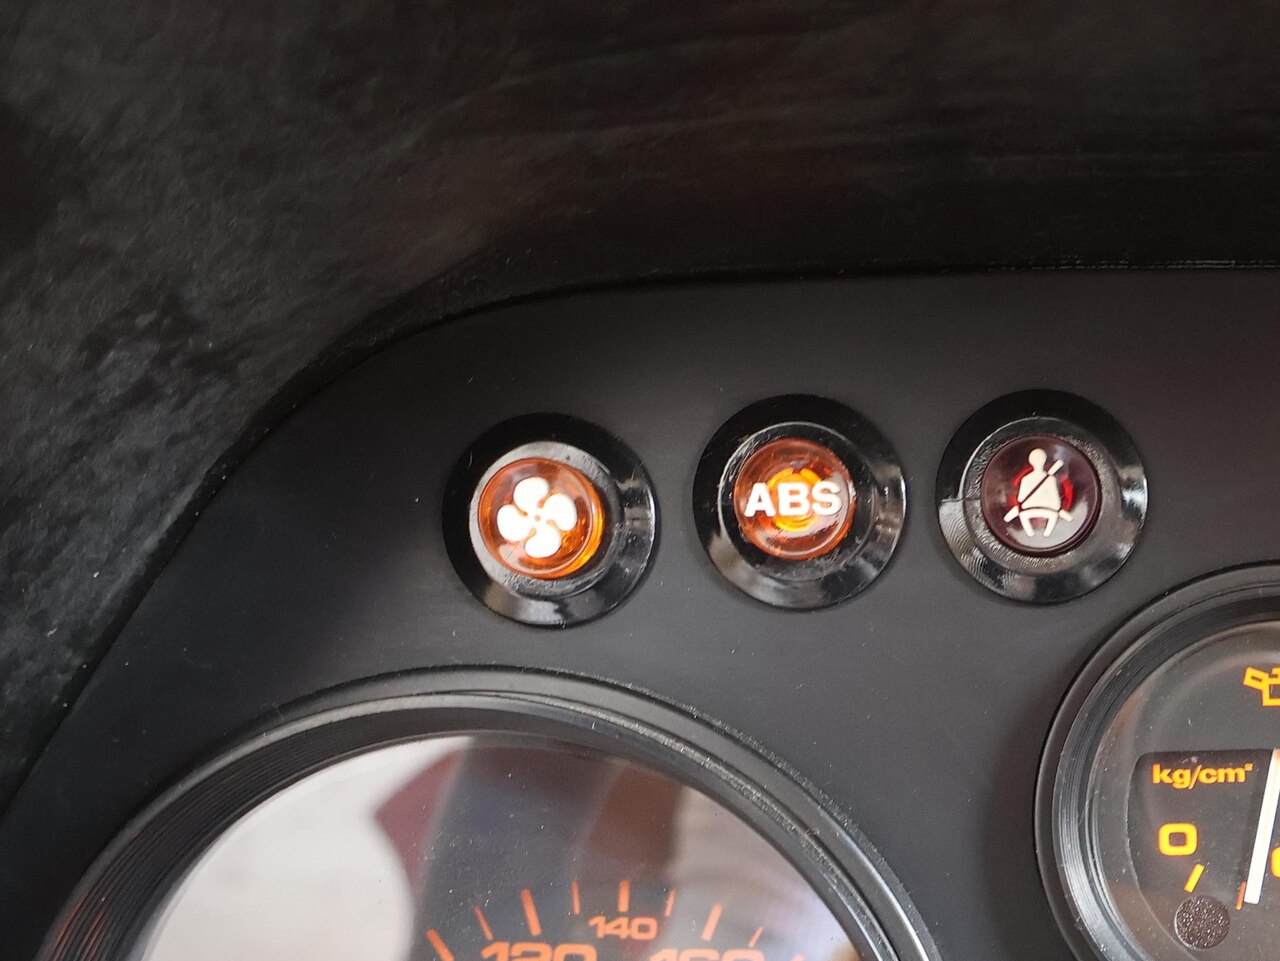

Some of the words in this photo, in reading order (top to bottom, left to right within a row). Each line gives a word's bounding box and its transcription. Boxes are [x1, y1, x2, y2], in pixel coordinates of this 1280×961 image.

[743, 481, 842, 519] ABS
[1158, 822, 1198, 857] 0
[589, 917, 657, 941] 140
